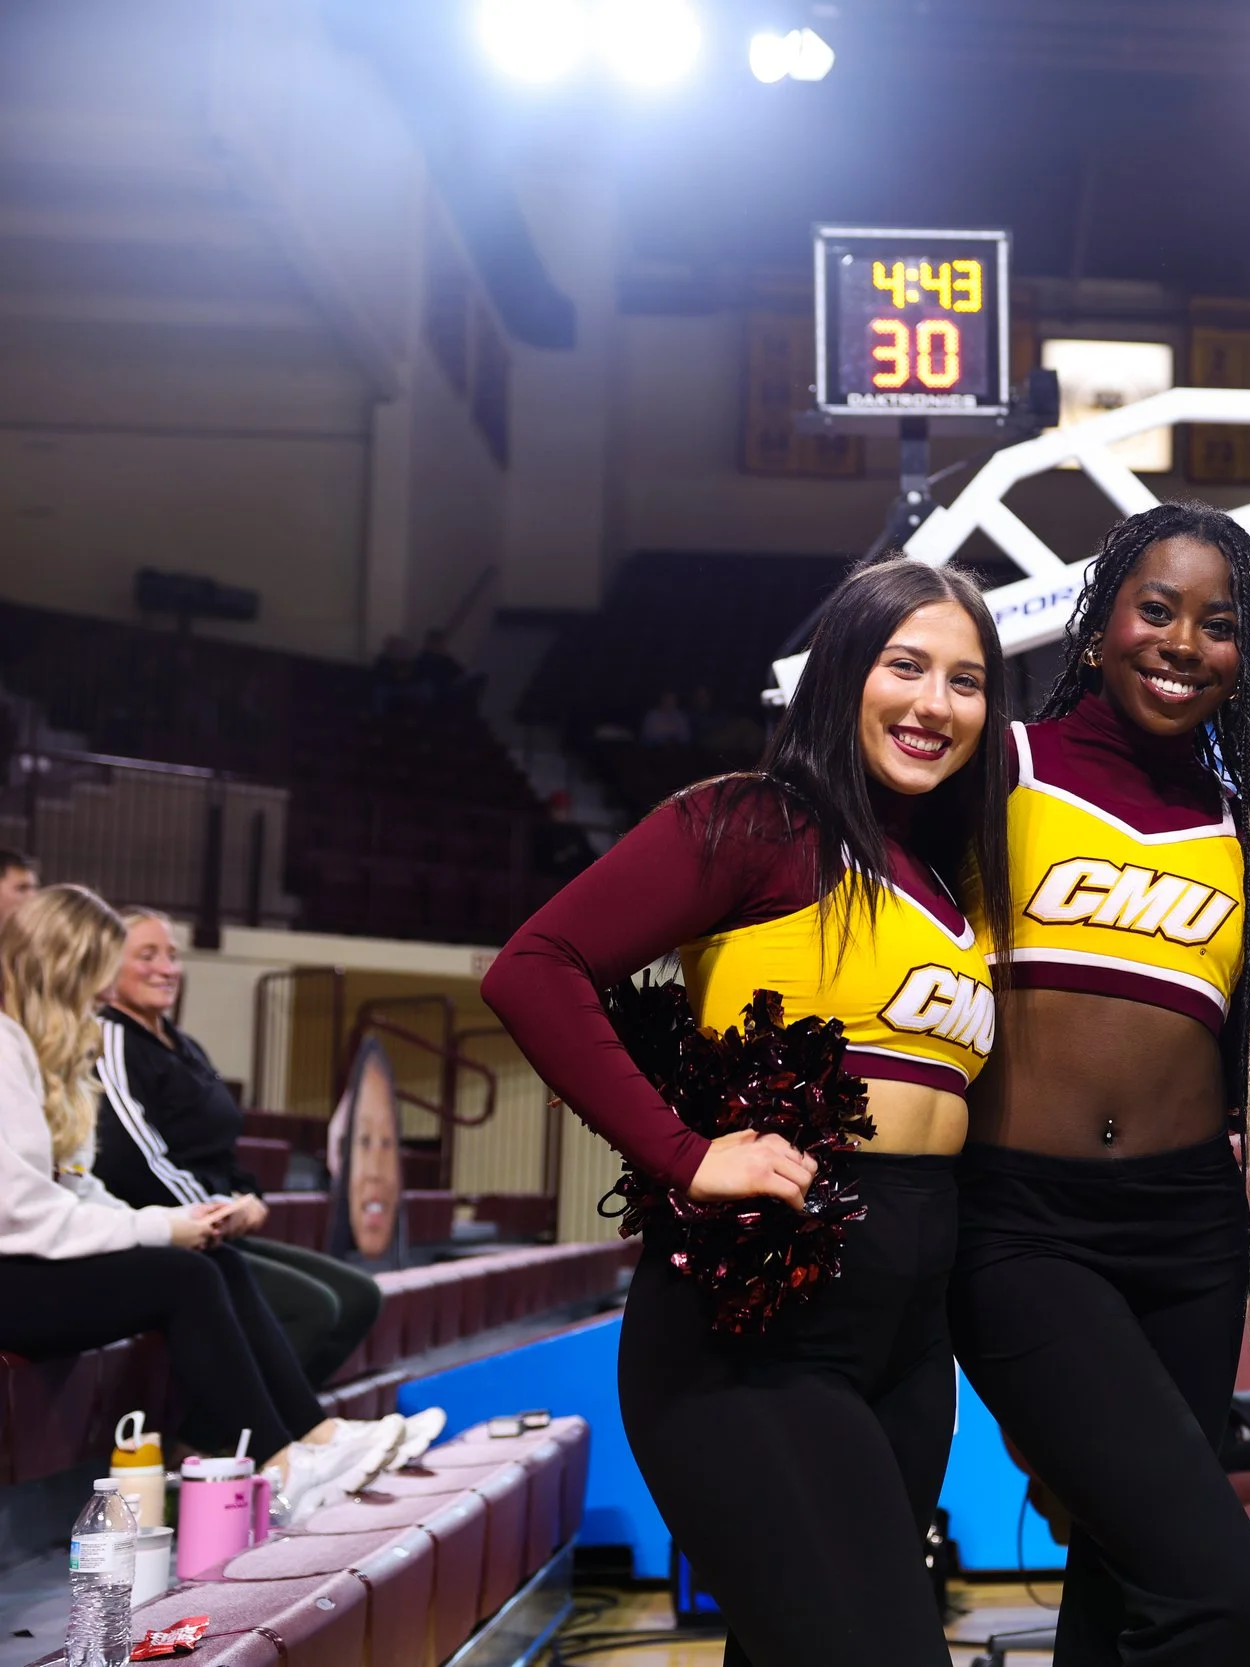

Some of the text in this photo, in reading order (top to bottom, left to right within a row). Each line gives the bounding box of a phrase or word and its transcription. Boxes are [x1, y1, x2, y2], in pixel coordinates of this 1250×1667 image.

[872, 260, 982, 313] 4:43
[871, 319, 960, 389] 30
[1022, 856, 1239, 947] CMU
[877, 963, 996, 1058] CMU
